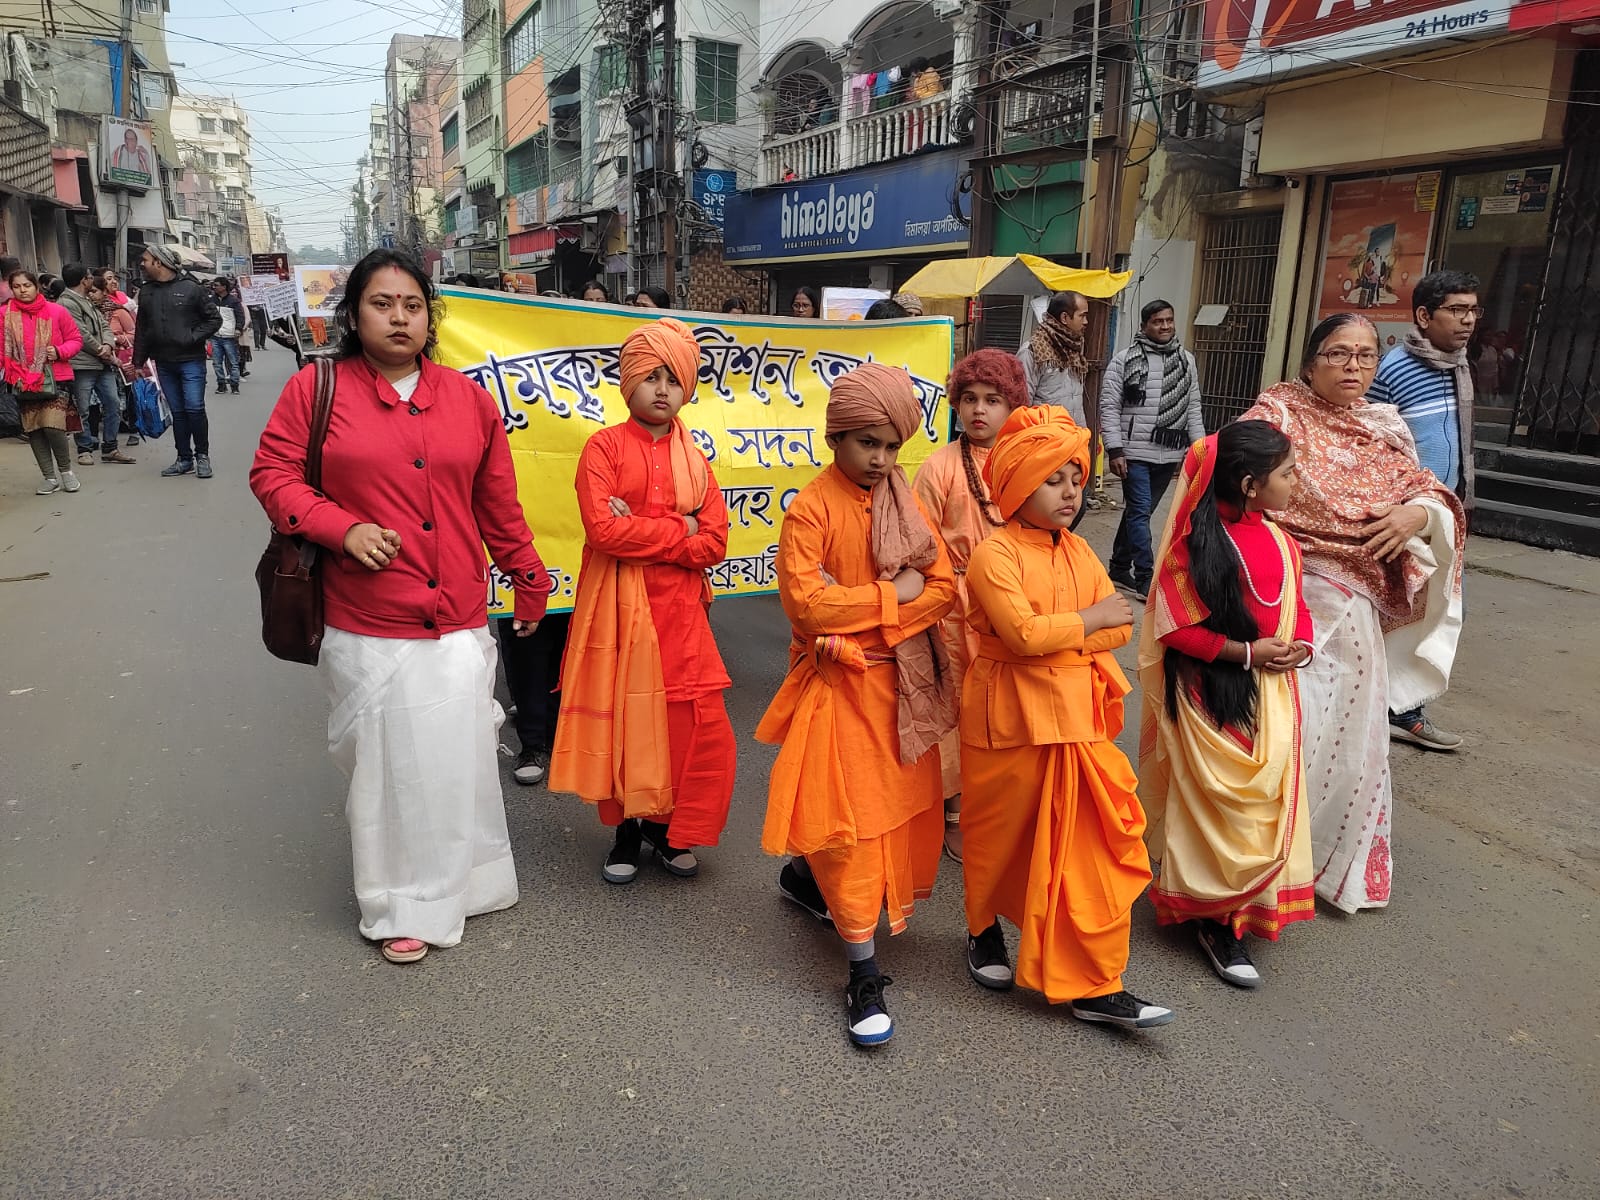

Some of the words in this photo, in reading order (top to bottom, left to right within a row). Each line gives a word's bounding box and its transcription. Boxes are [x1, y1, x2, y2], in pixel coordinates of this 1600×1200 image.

[1405, 21, 1426, 39] 24
[1432, 9, 1490, 34] Hours
[781, 183, 875, 245] himalaya
[726, 428, 823, 469] সদন
